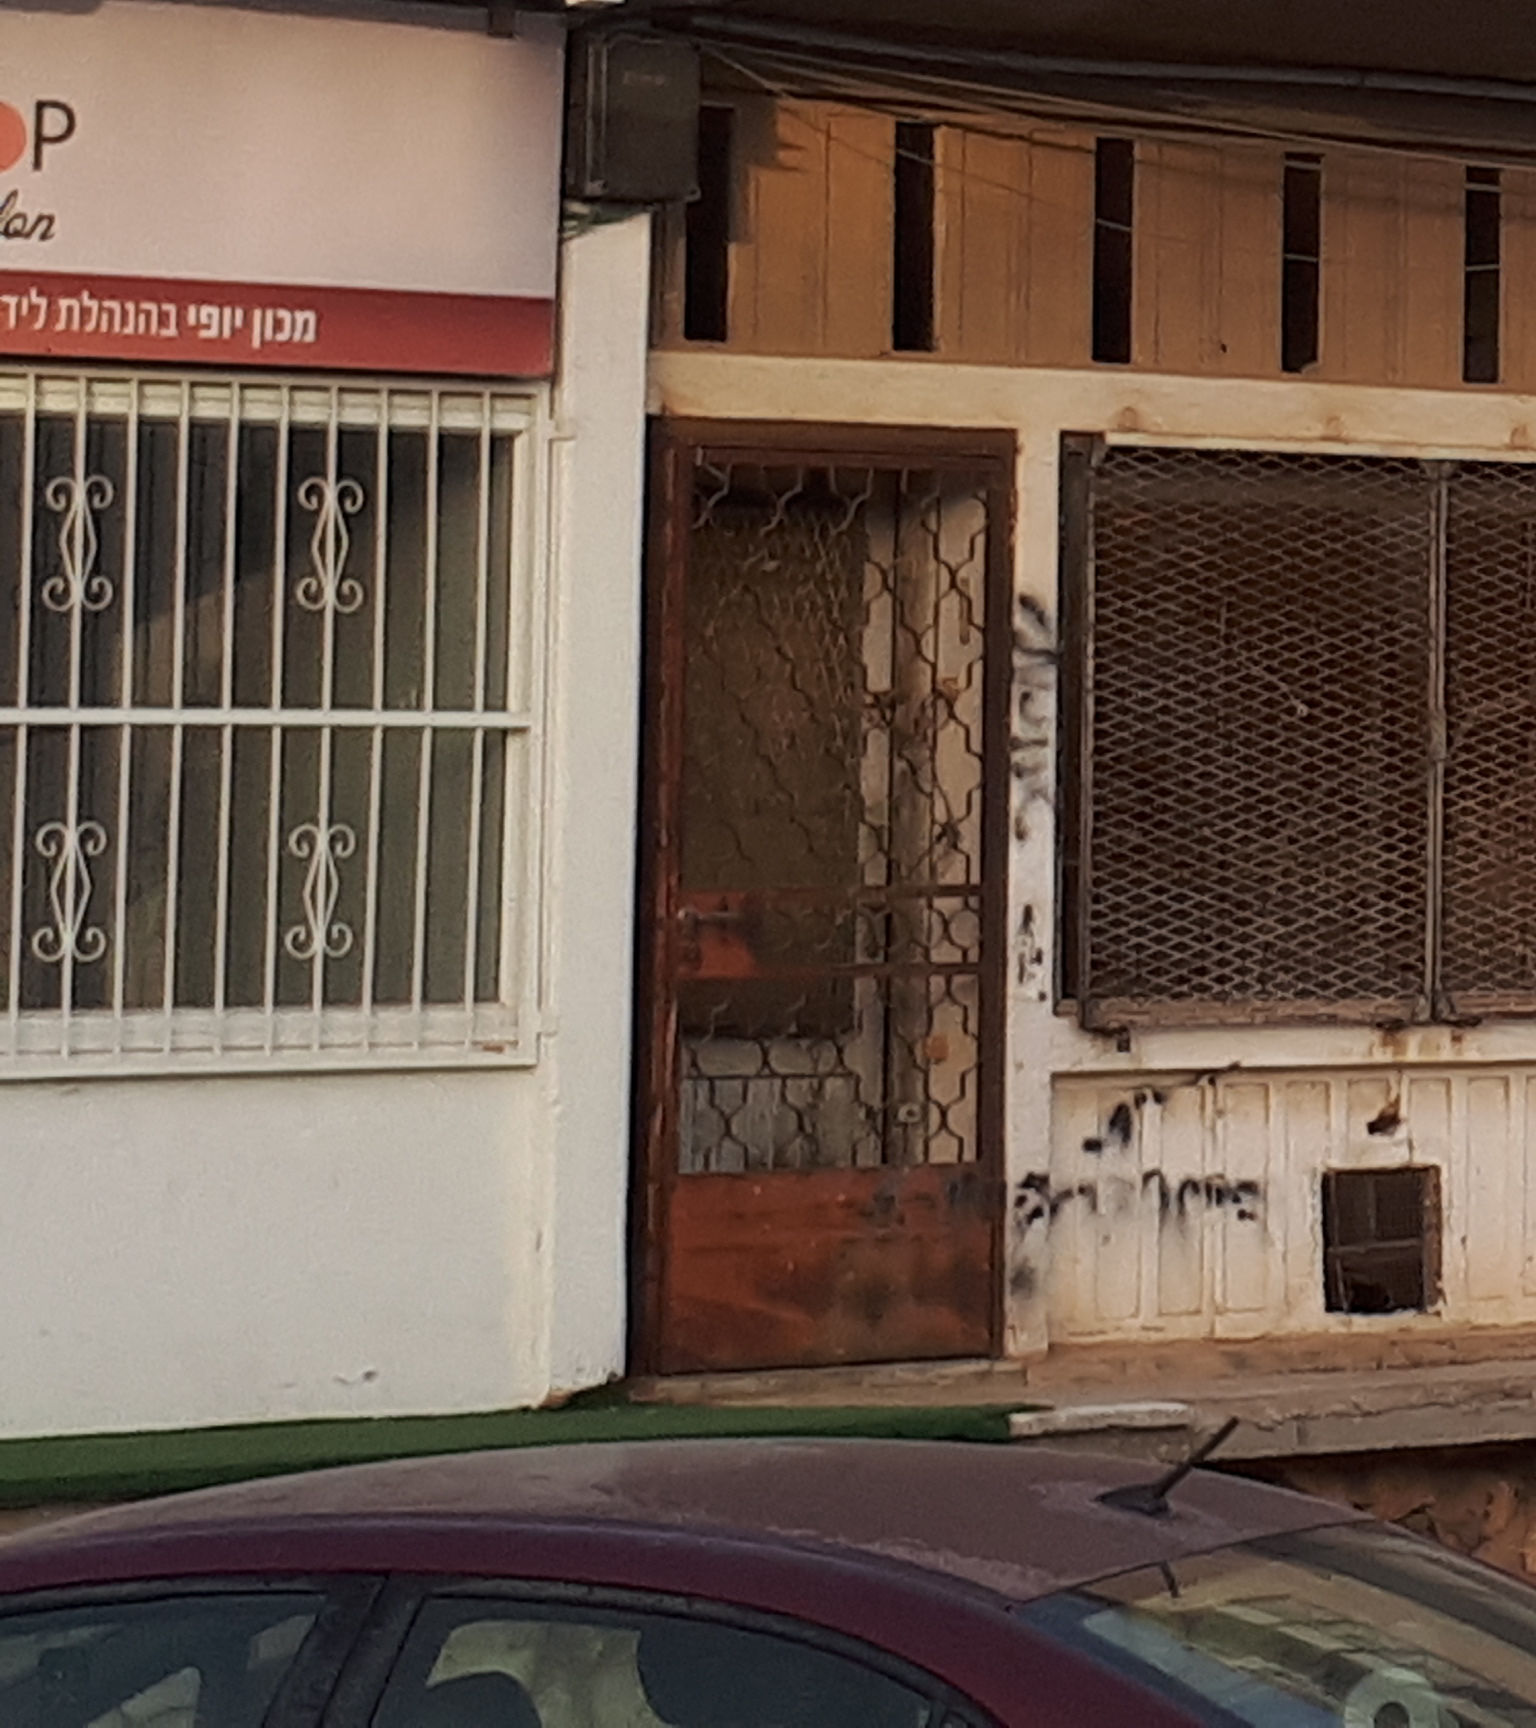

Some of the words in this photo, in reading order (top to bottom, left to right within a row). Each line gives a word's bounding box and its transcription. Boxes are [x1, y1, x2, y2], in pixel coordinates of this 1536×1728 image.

[54, 288, 179, 338] בהנהלת
[186, 302, 245, 340] יופי
[251, 307, 317, 349] מכון
